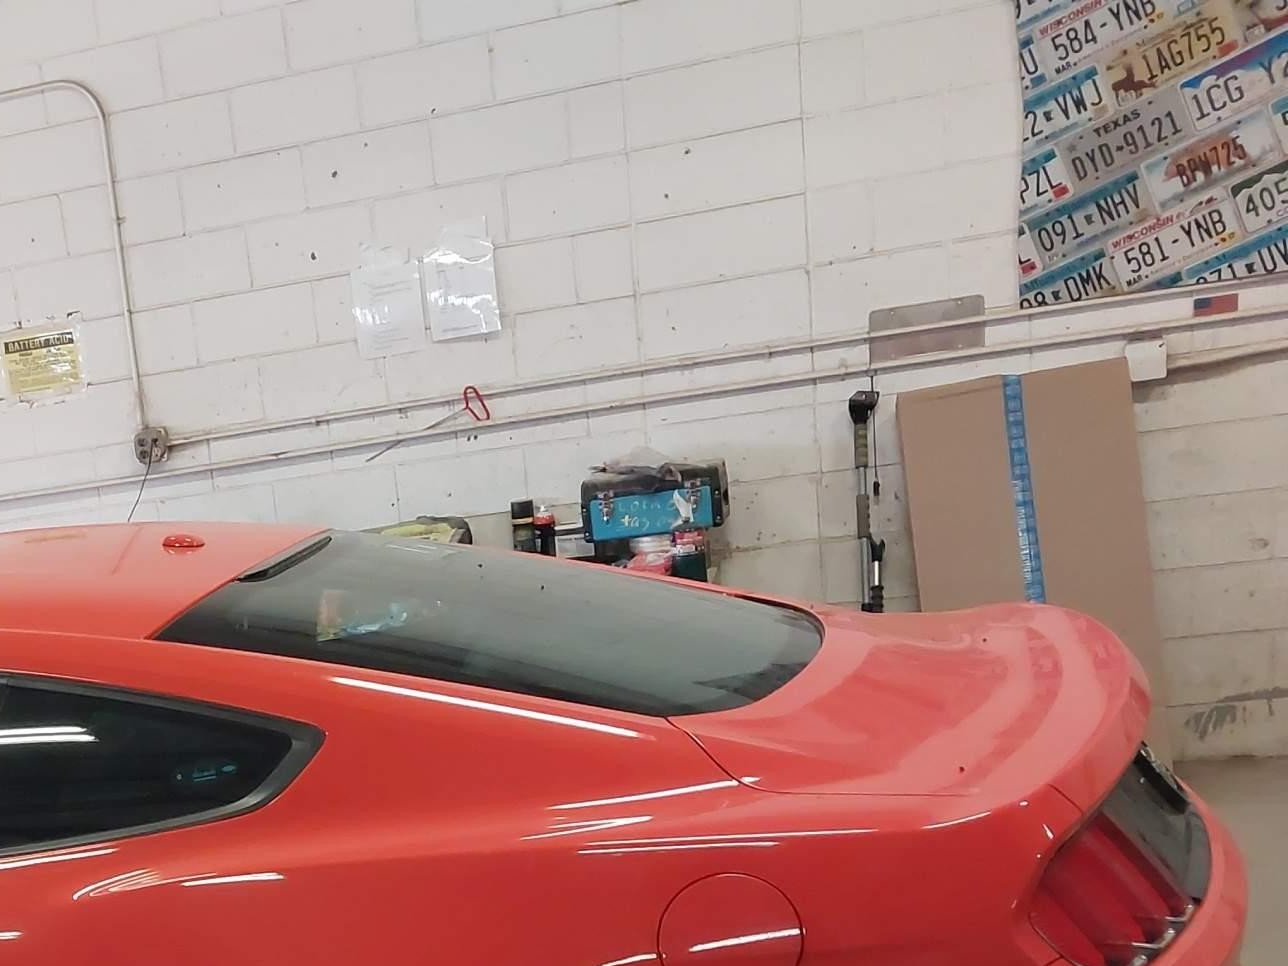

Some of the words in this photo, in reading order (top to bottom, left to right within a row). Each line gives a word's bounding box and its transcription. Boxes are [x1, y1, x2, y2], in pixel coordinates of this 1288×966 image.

[1141, 16, 1225, 82] 1AG755
[1192, 74, 1245, 122] 1CG
[1093, 108, 1141, 138] TEXAS
[1112, 214, 1175, 249] WISCONSIN
[7, 338, 45, 353] BATTERY
[49, 333, 69, 346] ACID
